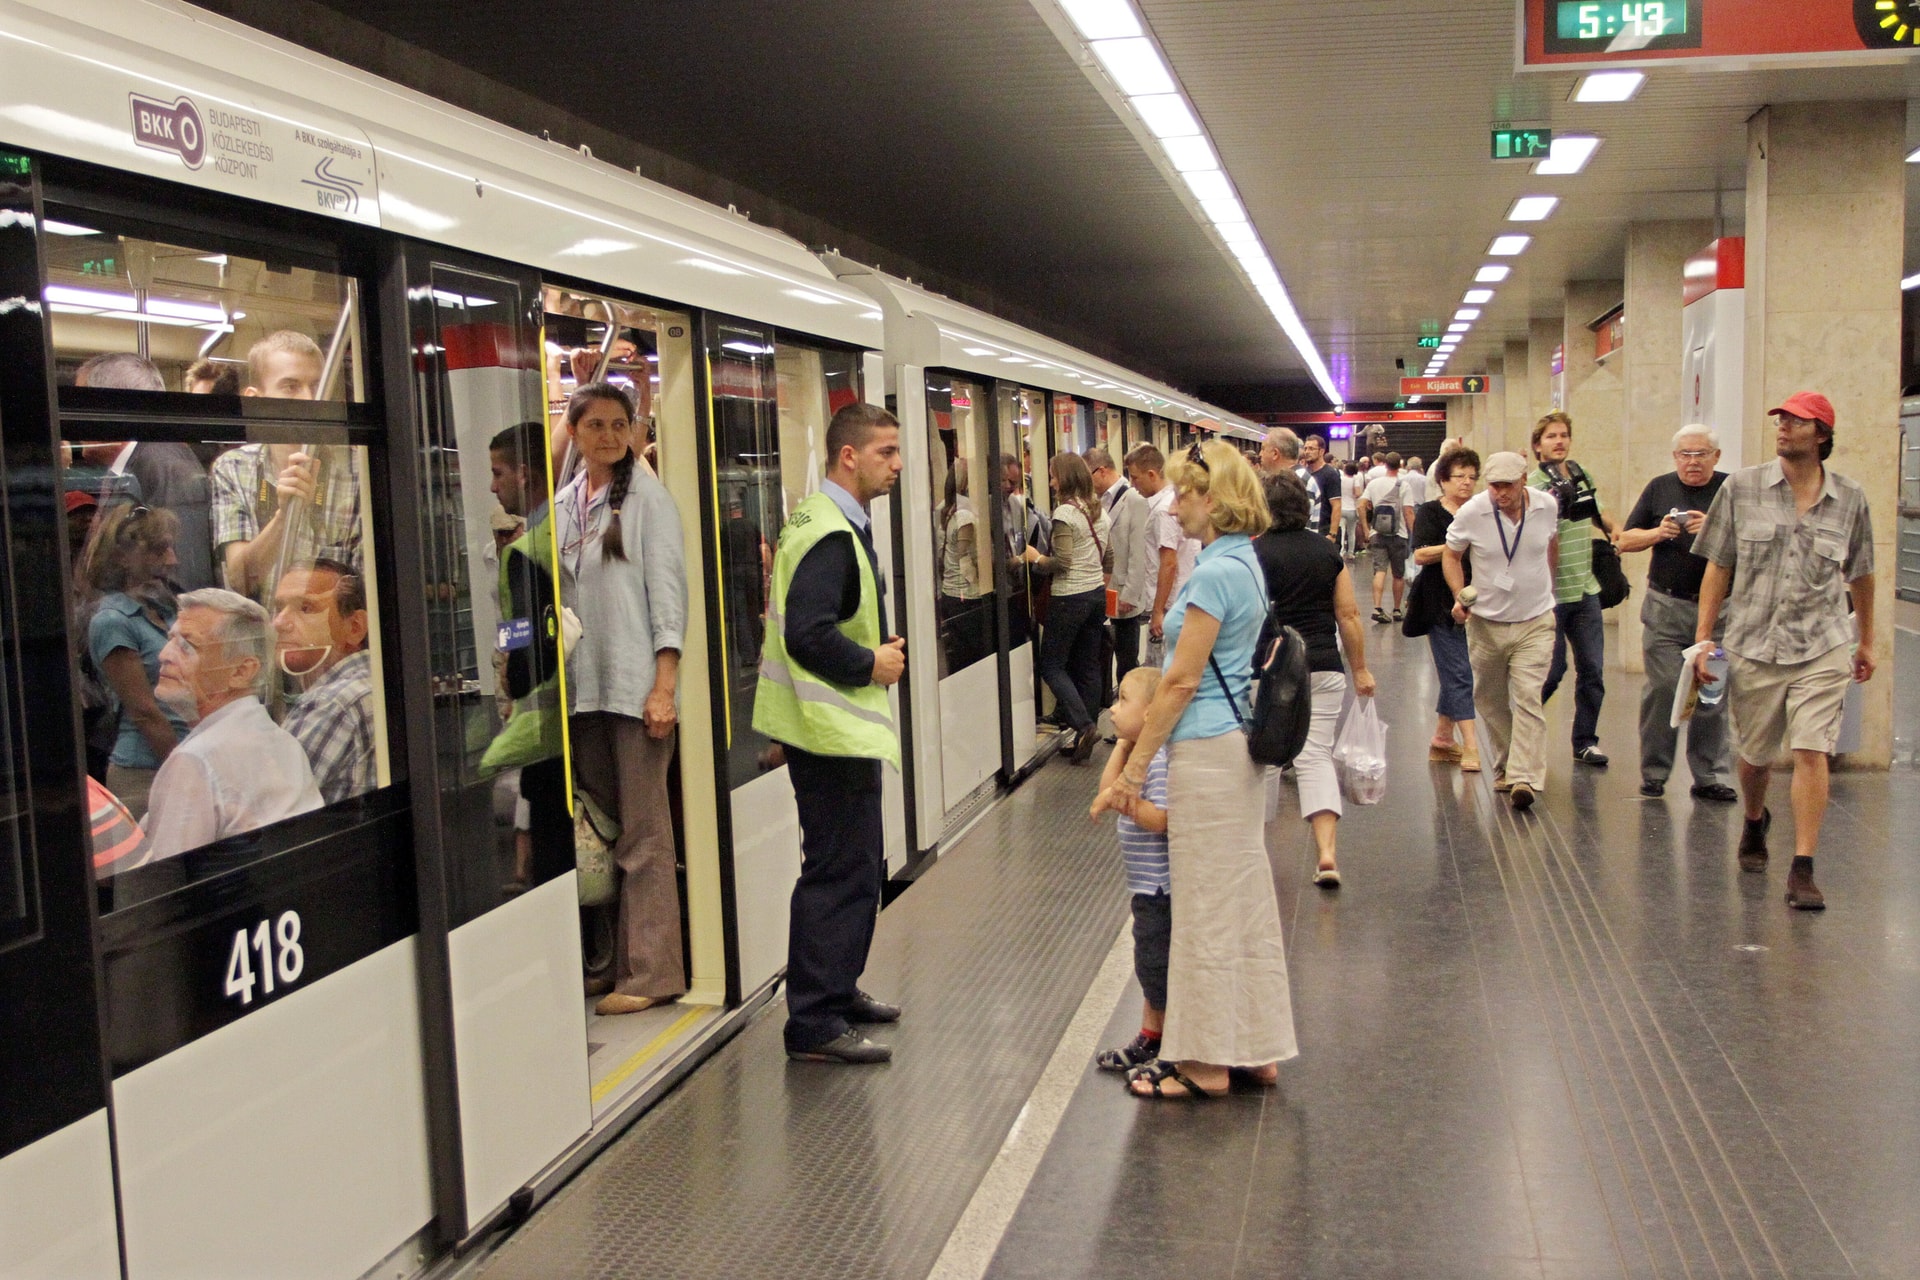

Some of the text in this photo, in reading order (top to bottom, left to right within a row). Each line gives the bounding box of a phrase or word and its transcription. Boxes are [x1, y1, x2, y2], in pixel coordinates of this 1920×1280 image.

[1578, 2, 1664, 39] 5:43
[140, 110, 175, 140] BKK
[209, 108, 261, 137] BUDAPESTI
[211, 130, 274, 163] KÖZLEKEDÉSI
[295, 129, 302, 142] A
[301, 131, 316, 147] BKK
[214, 153, 258, 180] KÖZPONT
[1426, 381, 1460, 392] Kijárat
[225, 909, 305, 1005] 418
